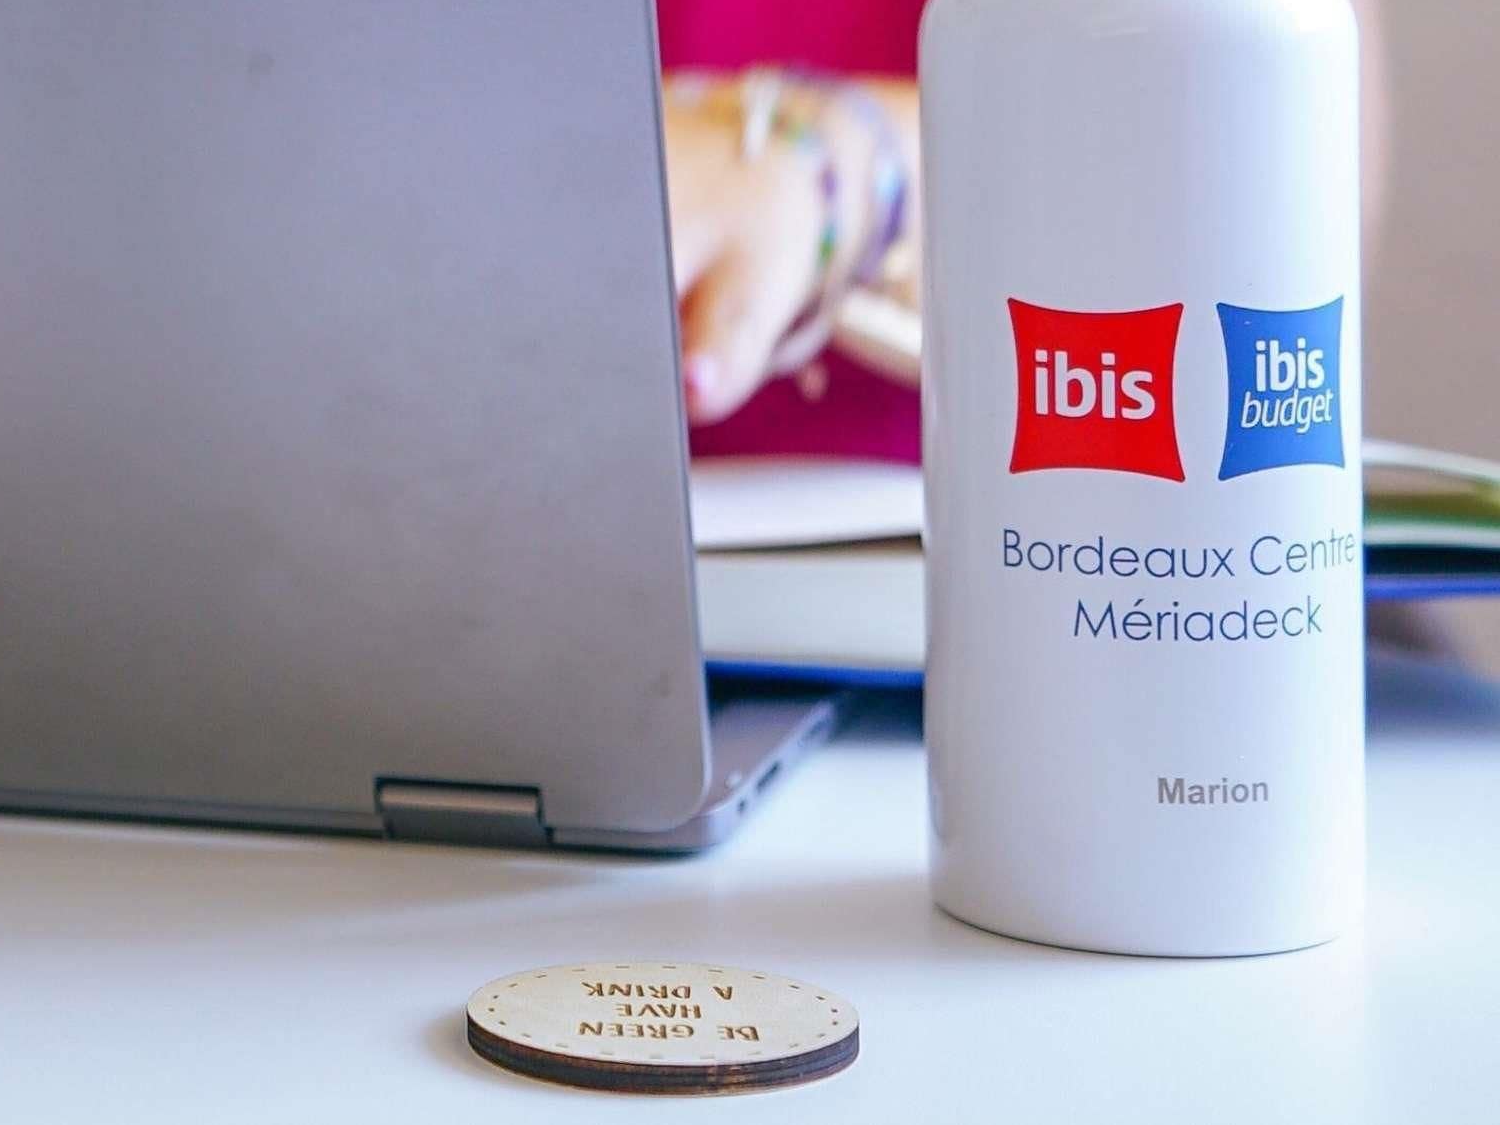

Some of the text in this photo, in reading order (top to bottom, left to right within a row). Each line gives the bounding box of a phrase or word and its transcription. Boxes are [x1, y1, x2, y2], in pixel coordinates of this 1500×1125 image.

[1034, 349, 1156, 420] ibis
[1255, 337, 1325, 392] ibis
[1240, 387, 1334, 433] budget
[1003, 528, 1356, 578] Bordeaux Centre
[1073, 595, 1322, 642] Mériadeck
[1157, 777, 1269, 804] Marion
[581, 982, 733, 1000] A DRINK
[614, 1004, 702, 1019] HAVE
[579, 1022, 759, 1041] BE GREEN
